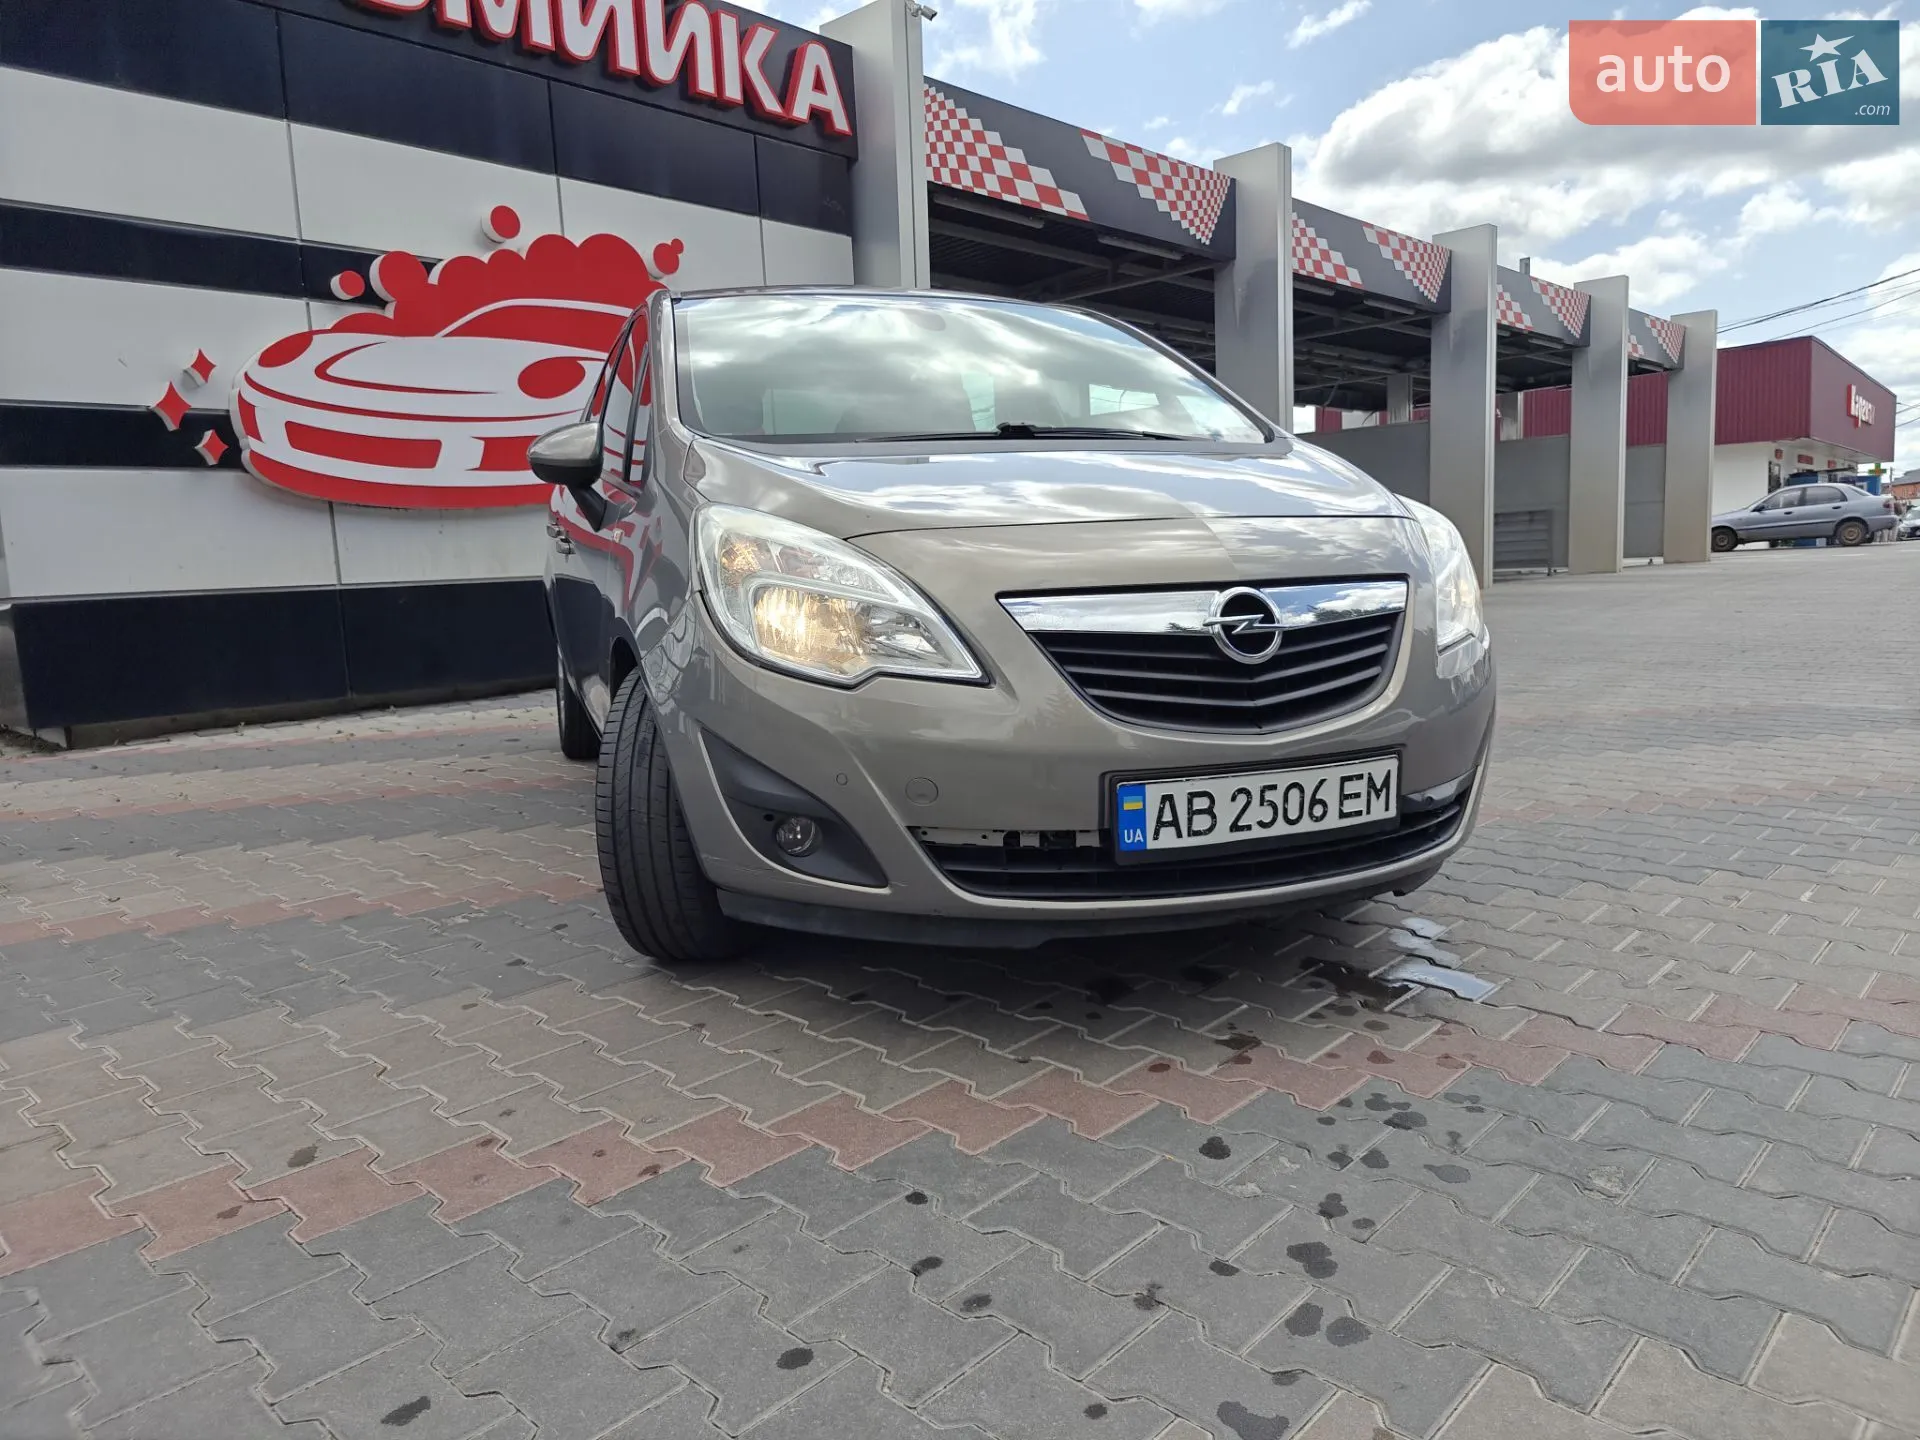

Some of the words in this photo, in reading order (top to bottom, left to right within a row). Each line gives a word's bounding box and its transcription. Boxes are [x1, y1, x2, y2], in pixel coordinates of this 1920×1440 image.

[1152, 790, 1217, 841] AB
[1229, 778, 1329, 833] 2506
[1338, 769, 1392, 820] EM
[1124, 828, 1144, 844] UA
